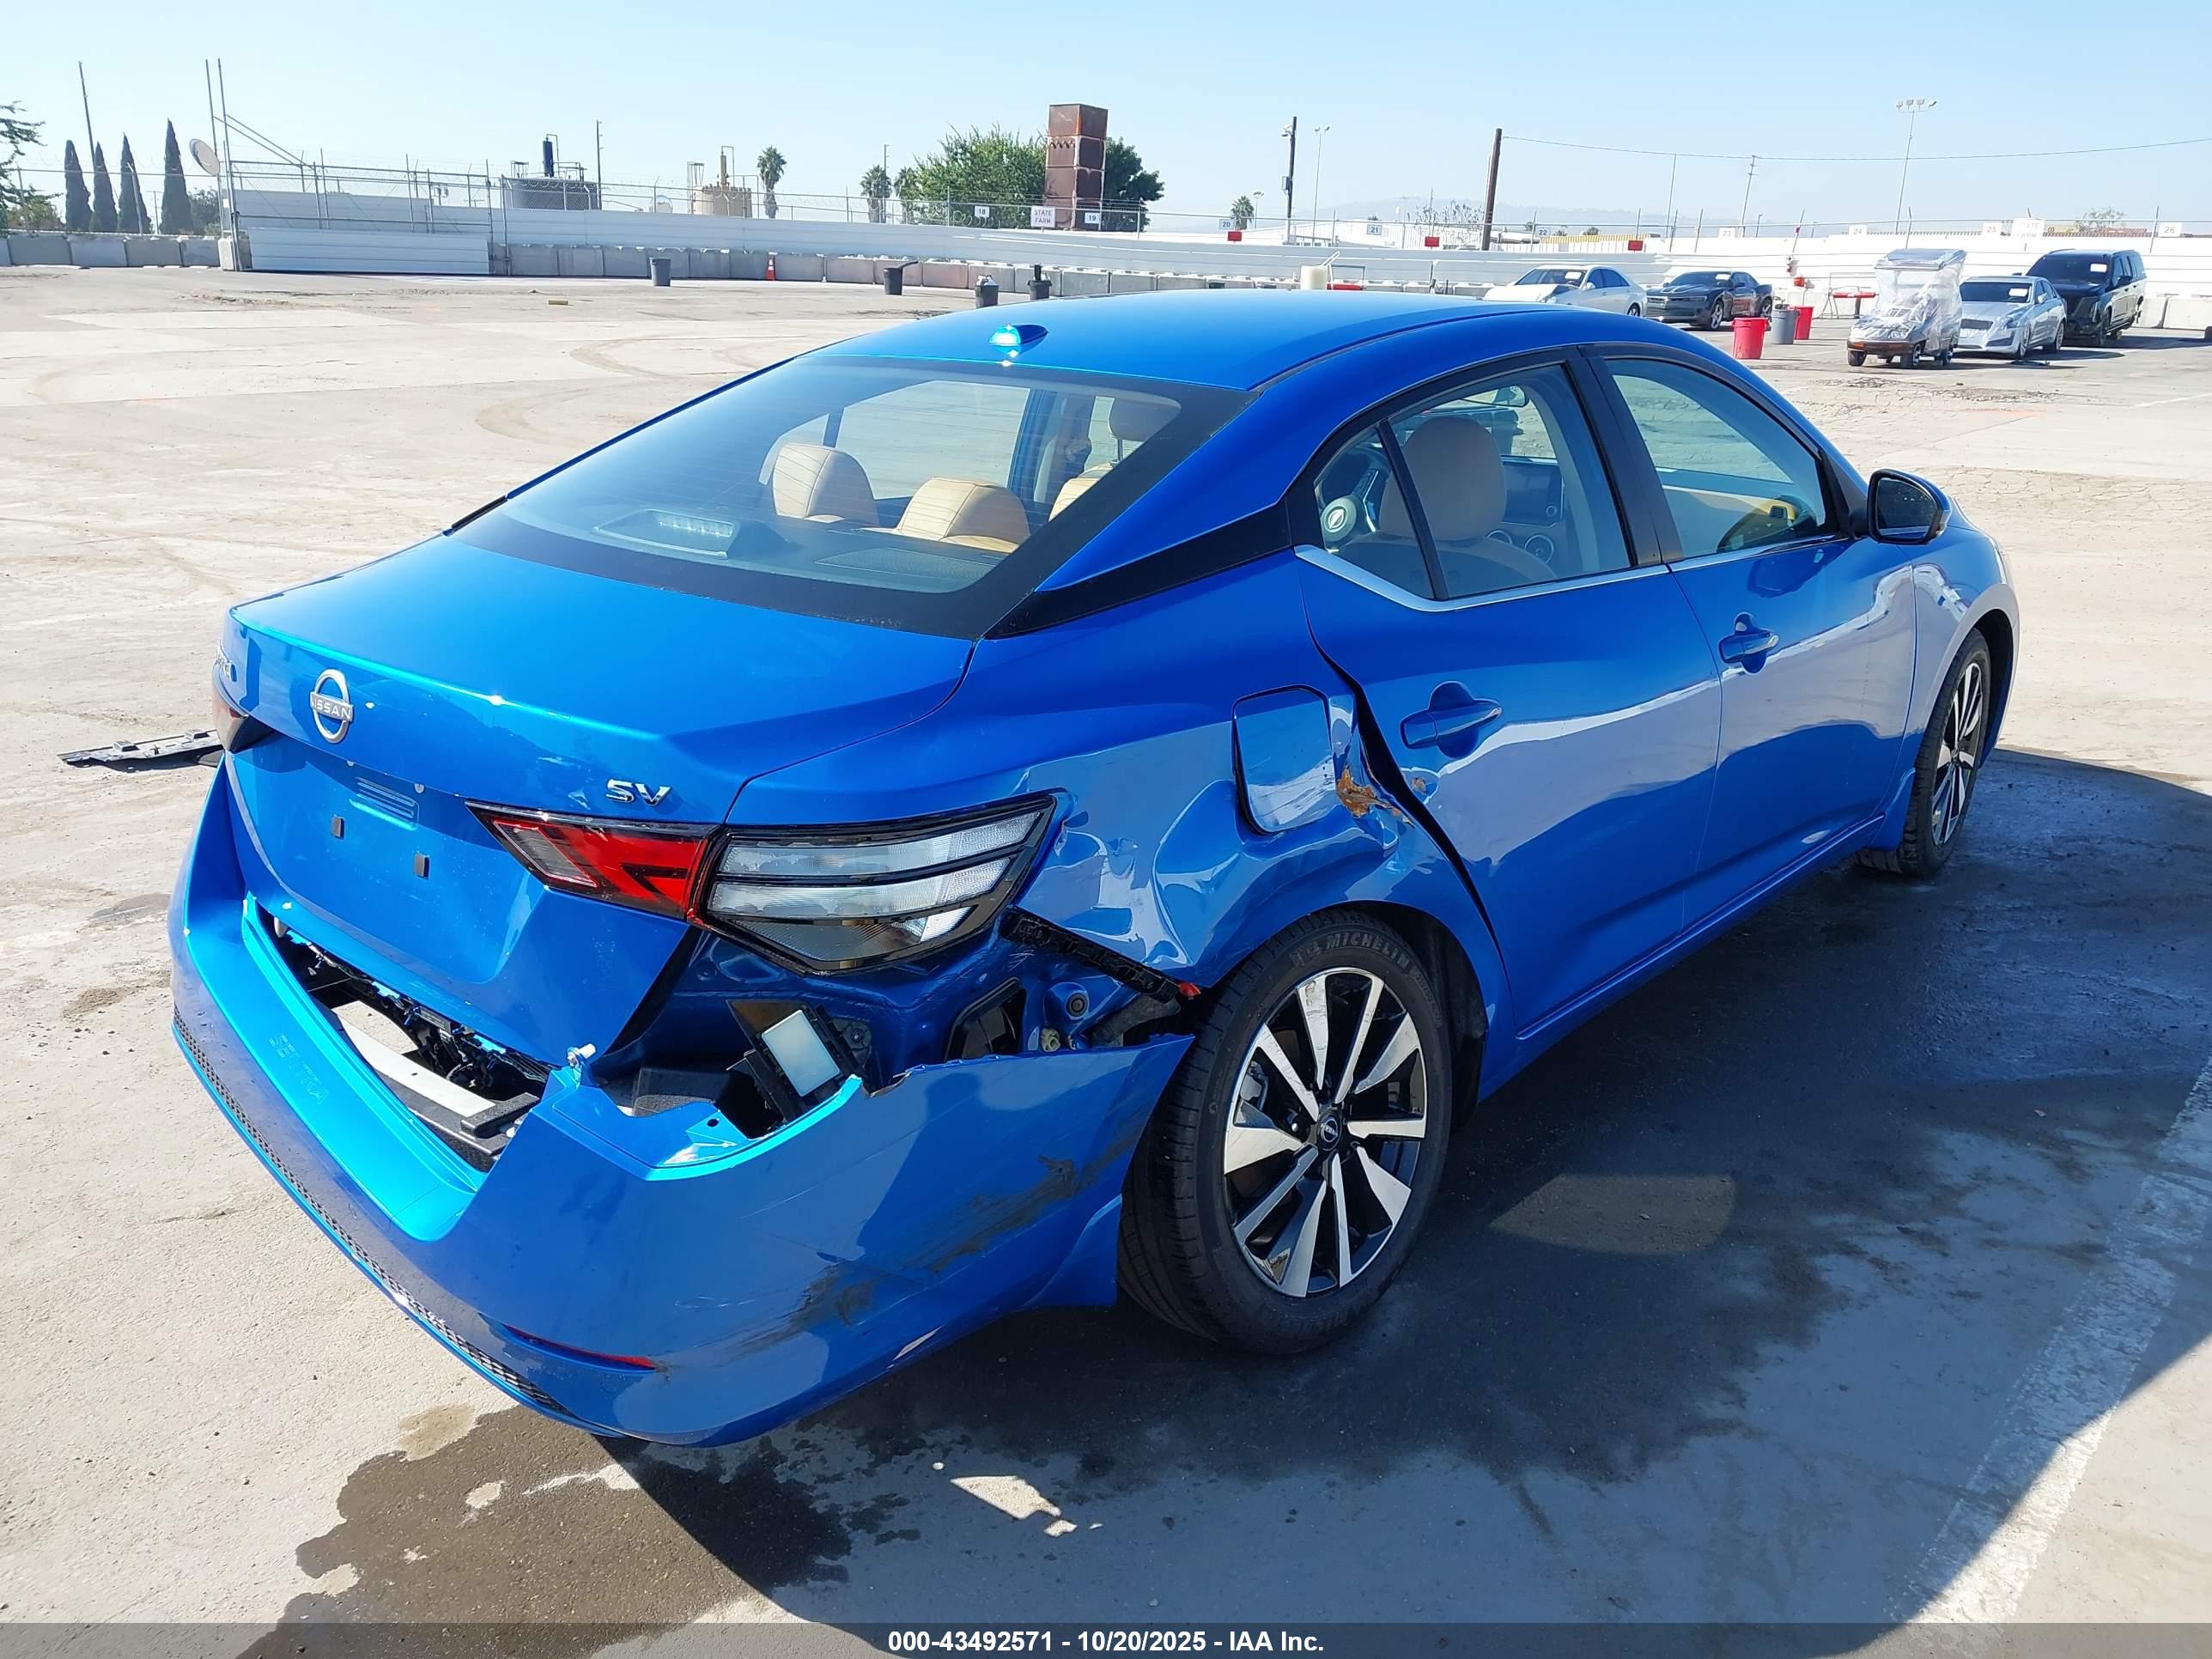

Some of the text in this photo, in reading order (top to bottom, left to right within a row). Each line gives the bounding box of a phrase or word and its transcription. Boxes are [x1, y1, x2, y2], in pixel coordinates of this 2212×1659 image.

[311, 695, 351, 720] ISSAN
[605, 779, 672, 806] SV
[1326, 932, 1410, 969] MICHELIN
[268, 1033, 330, 1106] SENTRA
